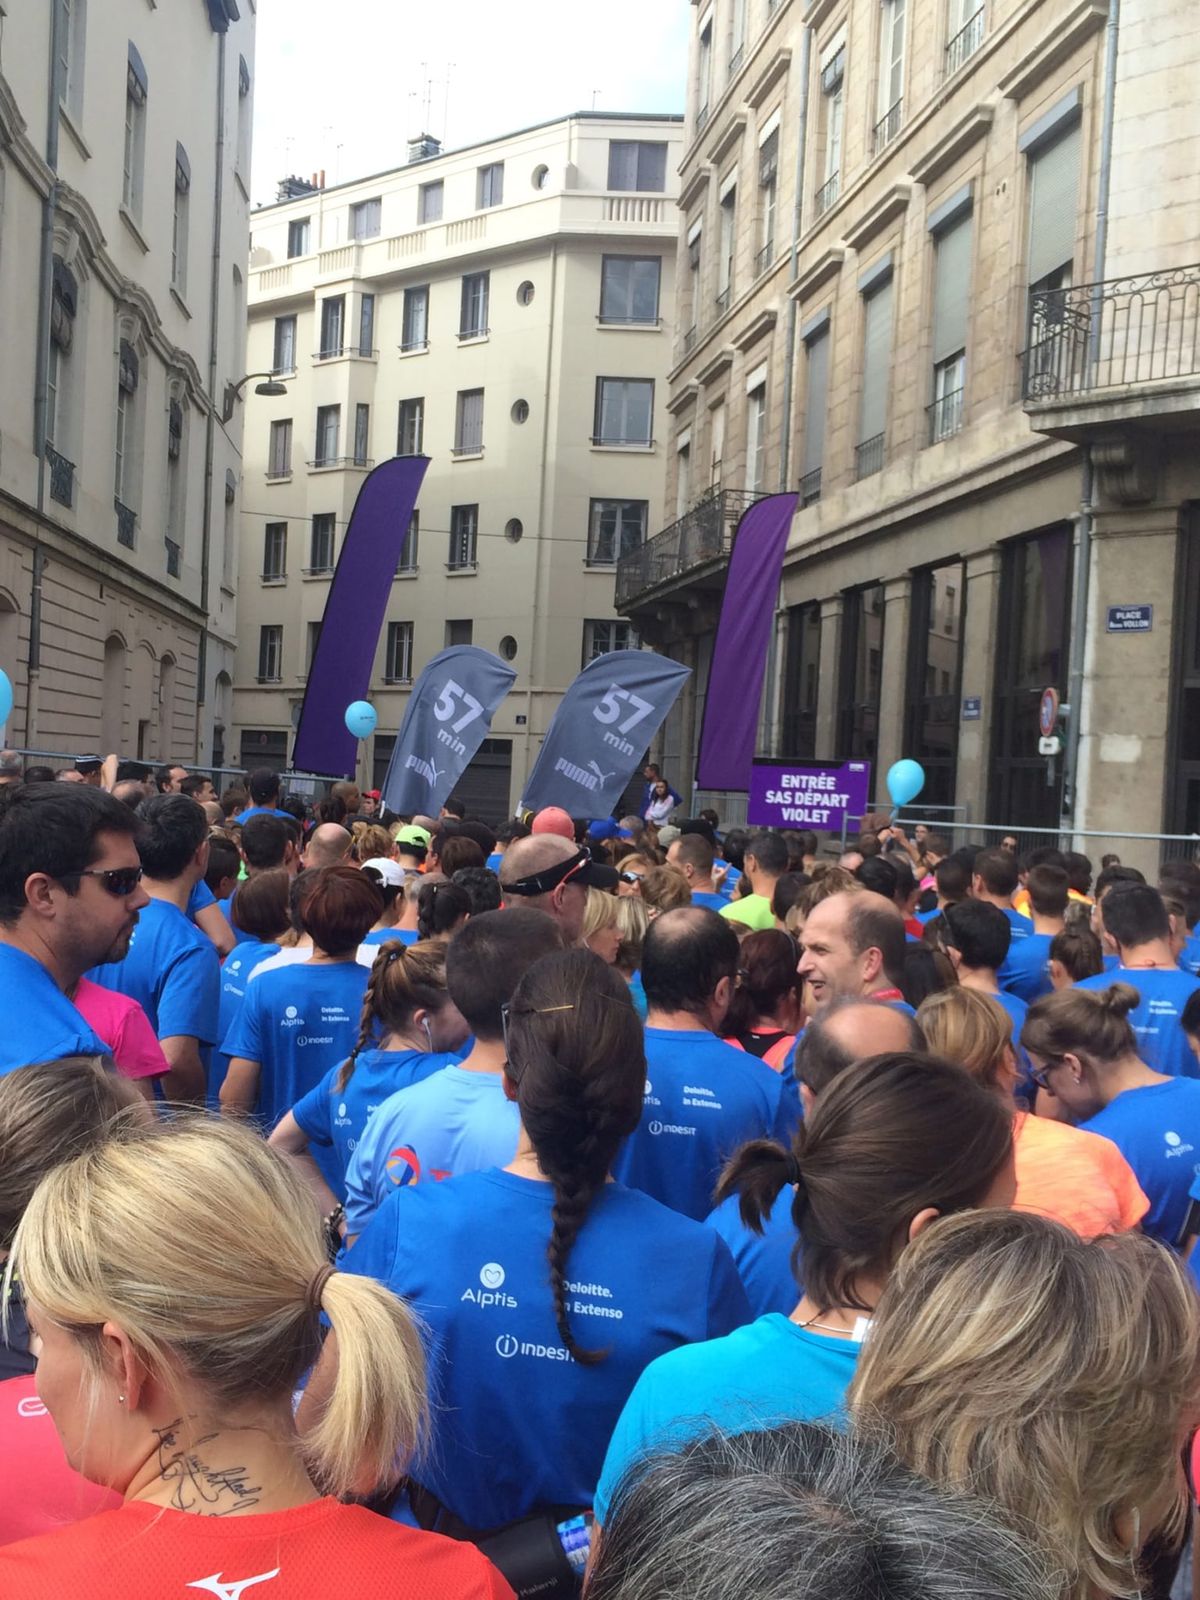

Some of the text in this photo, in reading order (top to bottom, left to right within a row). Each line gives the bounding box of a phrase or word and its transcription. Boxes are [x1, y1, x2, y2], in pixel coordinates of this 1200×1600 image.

[433, 679, 485, 734] 57
[592, 682, 656, 735] 57
[437, 728, 467, 756] min
[603, 731, 635, 757] min
[554, 757, 600, 792] PUMA
[781, 772, 837, 790] ENTRÉE
[765, 788, 850, 808] SAS DÉPART
[781, 808, 831, 823] VIOLET
[460, 1287, 518, 1309] Alptis
[574, 1301, 624, 1320] Extenso
